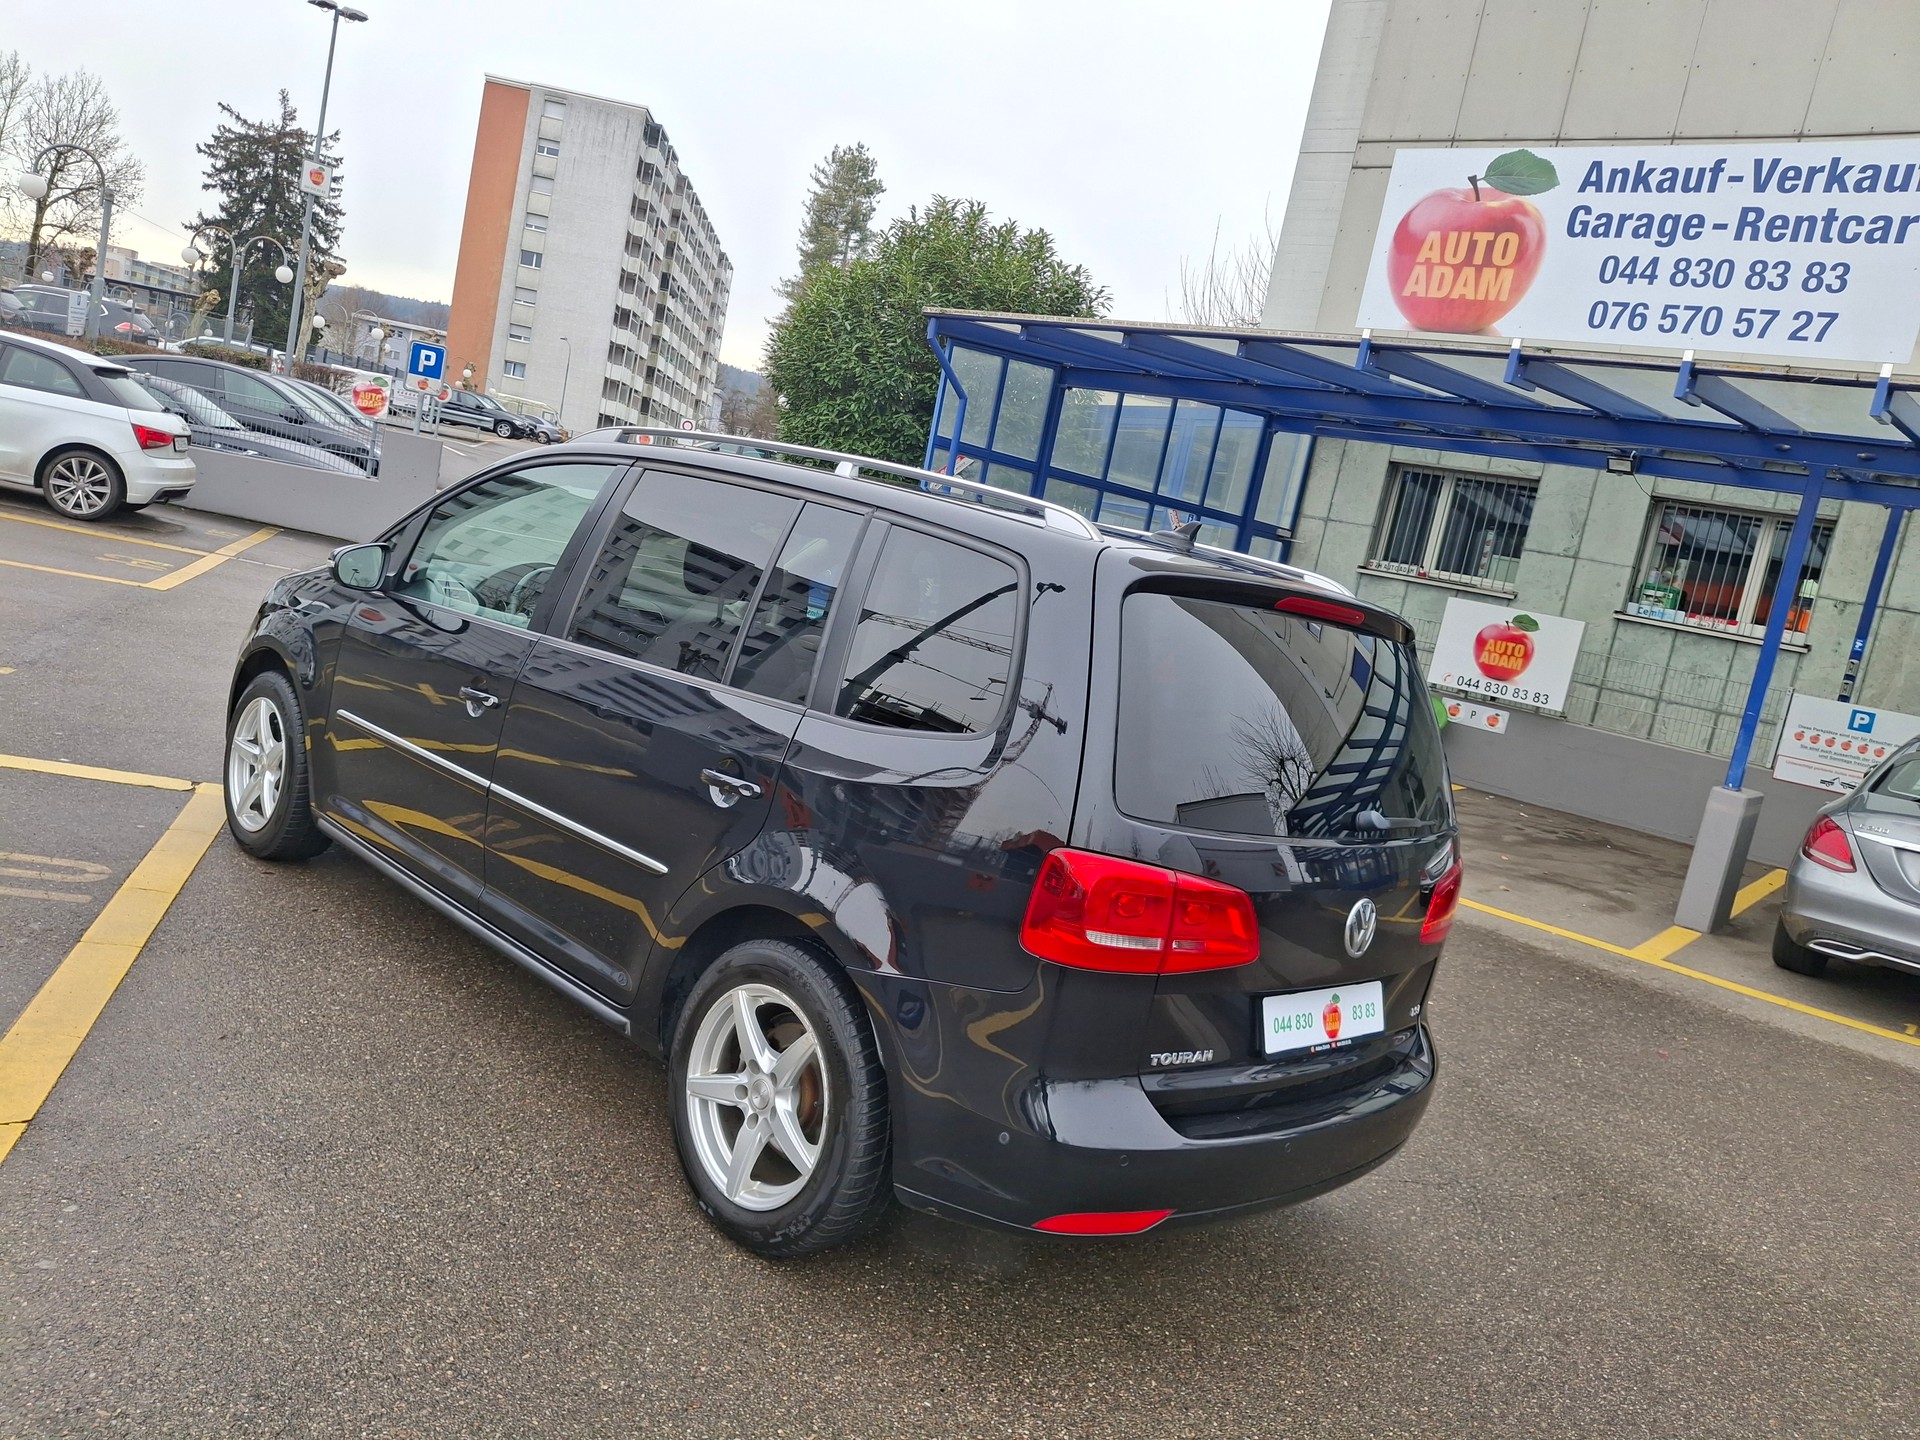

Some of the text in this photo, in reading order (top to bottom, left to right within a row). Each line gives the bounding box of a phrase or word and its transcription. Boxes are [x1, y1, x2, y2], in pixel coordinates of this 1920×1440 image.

[1415, 231, 1519, 267] AUTO
[1401, 264, 1514, 302] ADAM
[1599, 255, 1851, 294] 044 830 83 83
[1587, 300, 1839, 342] 076 570 57 27
[418, 349, 437, 372] P
[359, 391, 382, 401] AUTO
[1479, 651, 1524, 671] ADAM
[1484, 638, 1526, 658] AUTO
[1456, 675, 1550, 705] 044 830 83 83
[1853, 712, 1870, 729] P
[1273, 1002, 1376, 1034] 044 830 83 83
[1150, 1049, 1214, 1067] TOURAN
